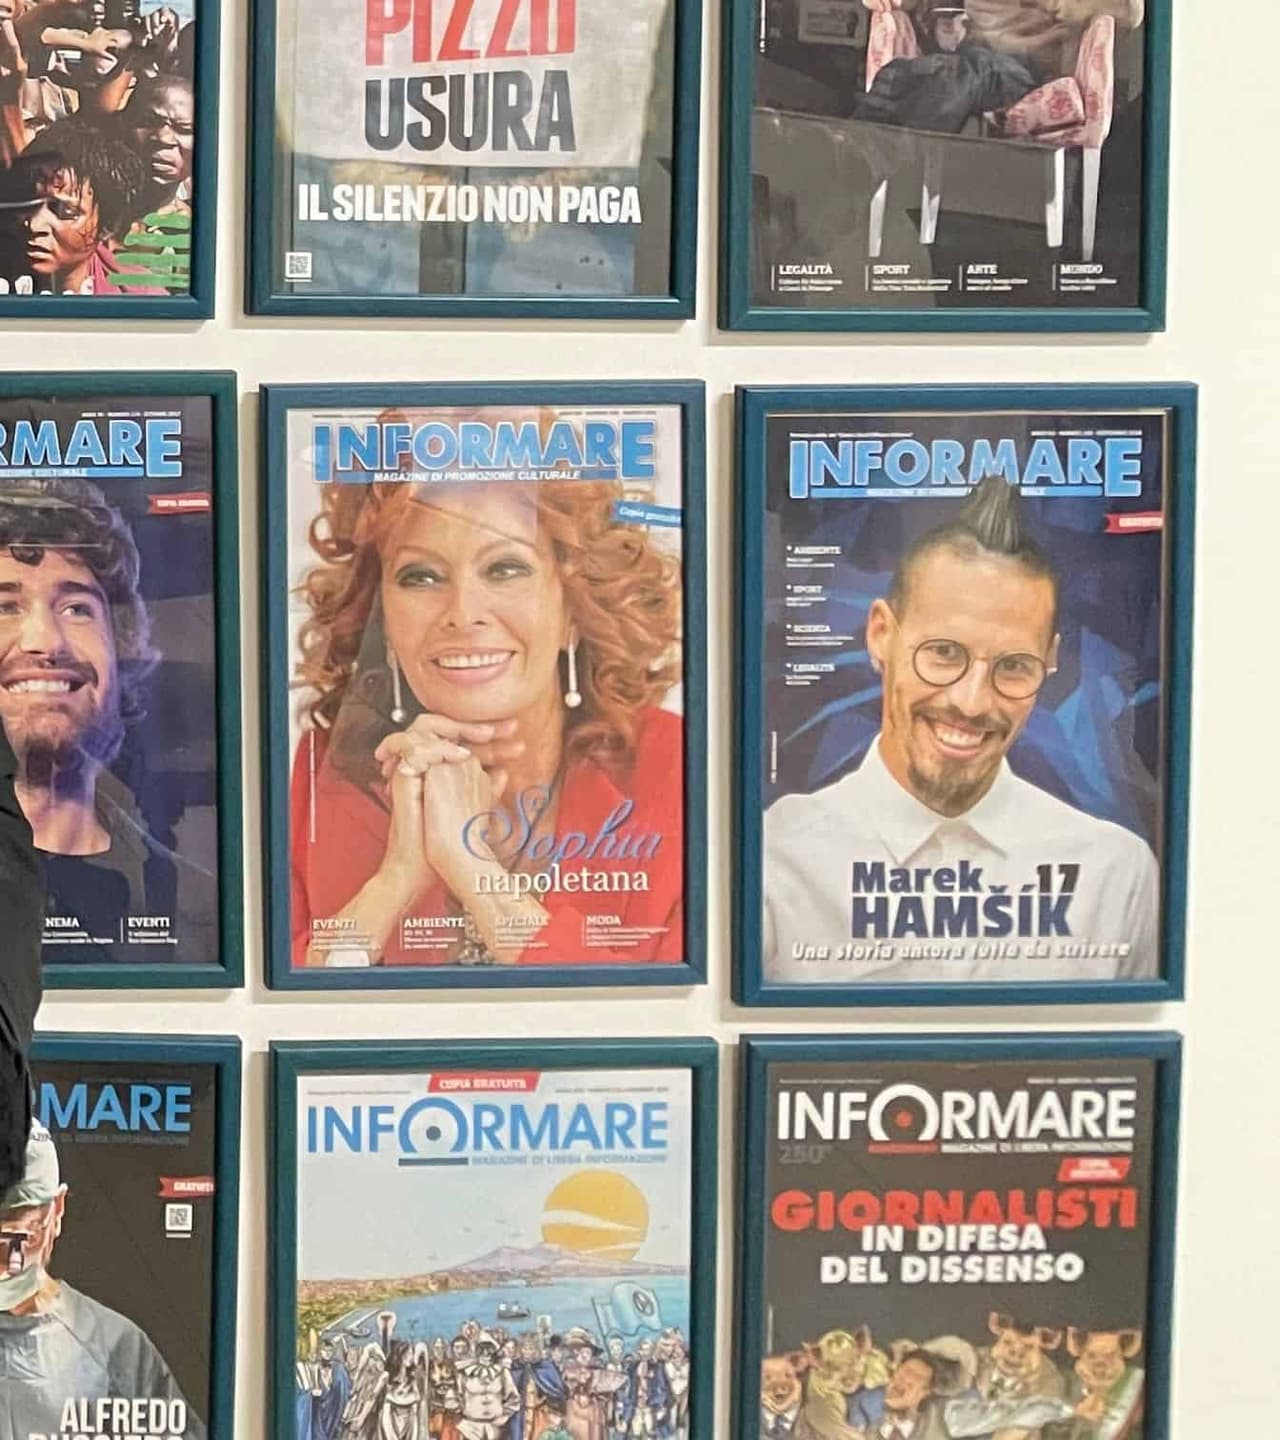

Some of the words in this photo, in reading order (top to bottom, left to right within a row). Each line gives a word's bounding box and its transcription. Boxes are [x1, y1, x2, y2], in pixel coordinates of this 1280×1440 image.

[364, 69, 577, 152] USURA
[298, 184, 329, 221] IL
[332, 183, 479, 224] SILENZIO
[482, 184, 555, 224] NON
[558, 184, 642, 225] PAGA
[312, 421, 656, 484] INFORMARE
[789, 437, 1143, 499] INFORMARE
[374, 471, 430, 483] MAGAZINE
[432, 471, 444, 482] DI
[446, 471, 515, 483] PROMOZIONE
[518, 470, 581, 482] CULTURALE
[462, 783, 662, 863] Sophia
[474, 867, 649, 902] napoletana
[851, 860, 985, 896] Marek
[1035, 863, 1081, 894] 17
[128, 916, 171, 929] EVENTI
[312, 918, 356, 931] EVENTI
[404, 916, 466, 929] AMBIENTE
[586, 915, 621, 927] MODA
[850, 880, 1075, 940] HAMŠÍK
[307, 1096, 668, 1155] INFORMARE
[777, 1083, 1136, 1141] INFORMARE
[771, 1188, 1138, 1232] GIORNALISTI
[861, 1224, 903, 1252] IN
[918, 1222, 1047, 1251] DIFESA
[820, 1256, 889, 1284] DEL
[900, 1252, 1085, 1284] DISSENSO
[59, 1397, 187, 1433] ALFREDO
